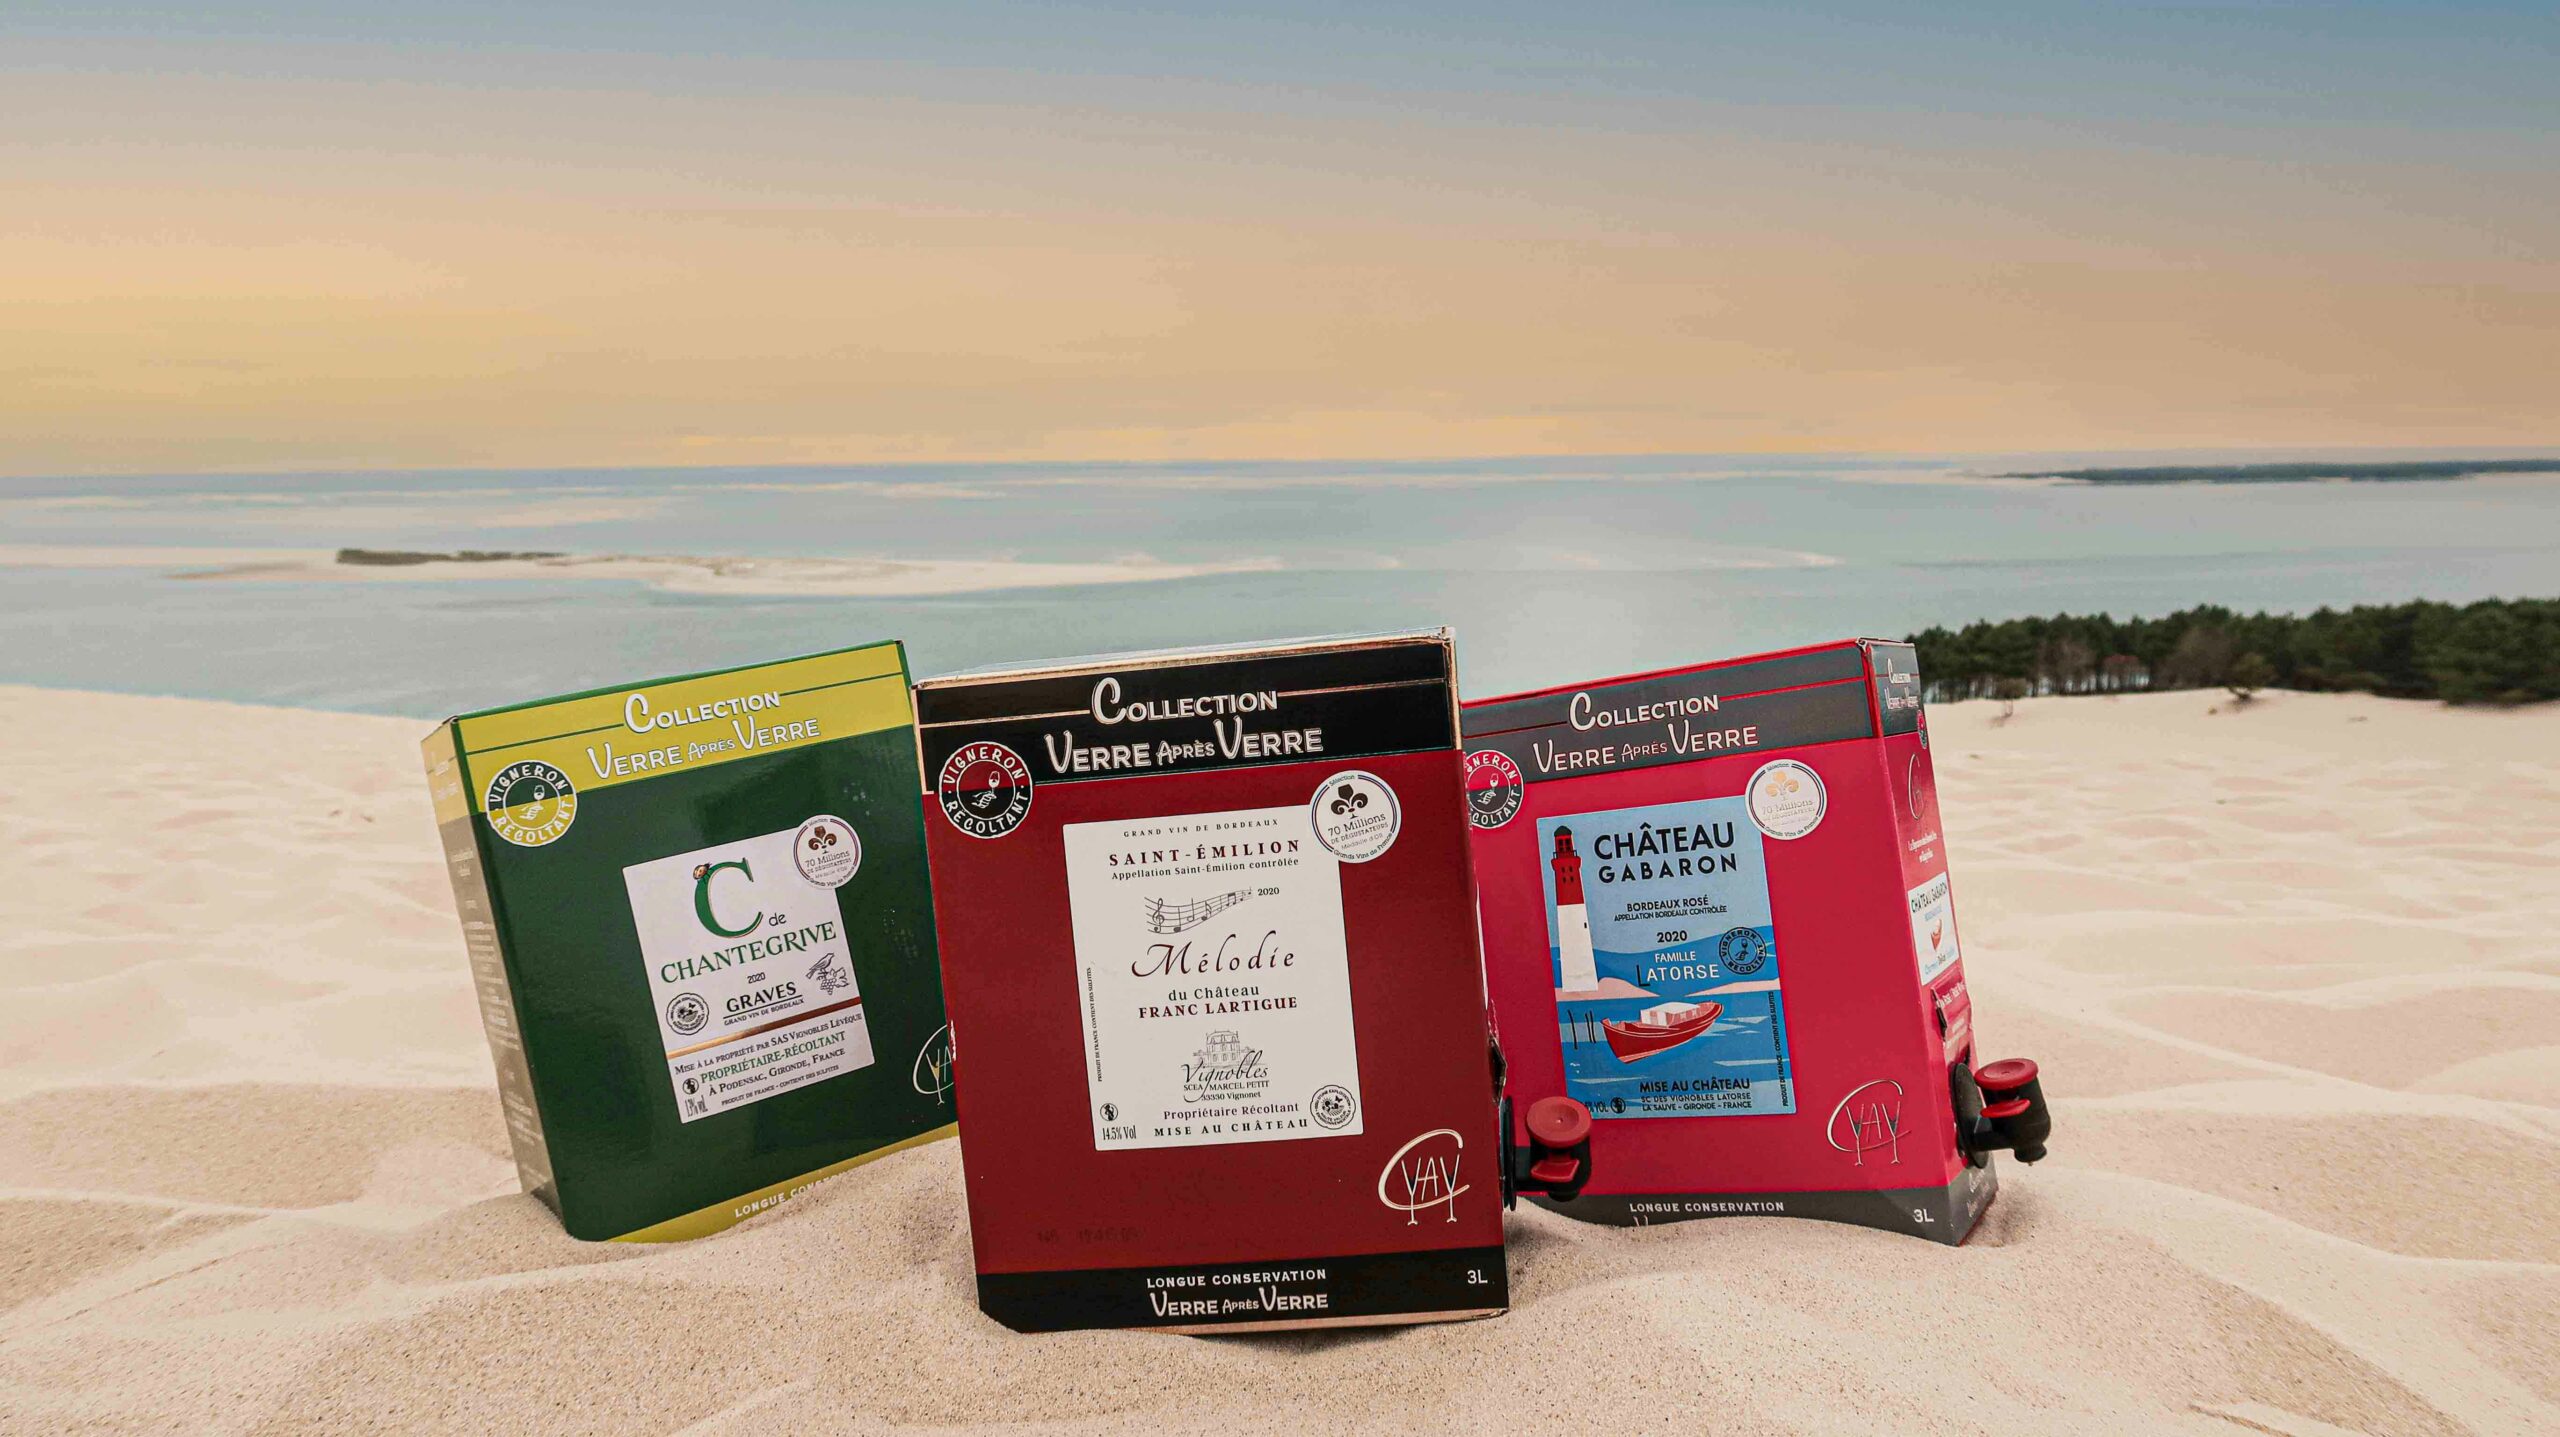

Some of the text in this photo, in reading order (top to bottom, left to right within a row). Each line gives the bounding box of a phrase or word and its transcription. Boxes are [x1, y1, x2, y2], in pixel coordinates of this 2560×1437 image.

[624, 691, 781, 733] COLLECTION
[1091, 677, 1278, 724] COLLECTION
[1569, 691, 1720, 731] COLLECTION
[586, 743, 684, 779] VERRE
[732, 715, 821, 750] VERRE
[1044, 715, 1323, 774] VERRE APRÈS VERRE
[1532, 739, 1616, 773] VERRE
[1667, 720, 1759, 755] VERRE
[943, 746, 1025, 784] VIGNERON
[489, 764, 568, 803] VIGNERON
[1124, 818, 1279, 838] GRAND VIN DE BORDEAUX
[1327, 813, 1386, 837] 70 Millions
[1594, 821, 1735, 860] CHÂTEAU
[817, 850, 850, 865] Millions
[1109, 839, 1299, 867] SAINT-ÉMILION
[1112, 857, 1299, 881] Appellation Saint-Émilion contrôlée
[1598, 853, 1738, 884] GABARON
[694, 857, 787, 938] C de
[1257, 886, 1280, 896] 2020
[1627, 894, 1709, 912] BORDEAUX ROSÉ
[1614, 904, 1727, 922] APPELLATION BORDEAUX CONTRÔLÉE
[1657, 930, 1688, 943] 2020
[1721, 930, 1756, 957] VIGNERON
[660, 921, 837, 983] CHANTEGRIVE
[1131, 930, 1294, 977] Mélodie
[1655, 951, 1696, 963] FAMILLE
[747, 972, 766, 984] 2020
[1636, 963, 1720, 987] LATORSE
[726, 982, 797, 1013] GRAVES
[1168, 986, 1260, 1001] du Château
[724, 999, 804, 1026] GRAND VIN DE BORDEAUX
[1139, 996, 1298, 1019] FRANC LARTIGUE
[701, 1031, 846, 1084] PROPRIÉTAIRE-RÉCOLTANT
[704, 1058, 714, 1067] LA
[756, 1042, 770, 1051] PAR
[771, 1033, 789, 1047] SAS
[709, 1084, 717, 1096] À
[812, 1048, 846, 1065] FRANCE
[1181, 1049, 1269, 1103] Vignobles
[1183, 1084, 1204, 1092] SCEA
[1209, 1081, 1245, 1091] MARCEL
[1226, 1091, 1262, 1101] Vignonet
[1640, 1076, 1750, 1093] MISE AU CHÂTEAU
[1780, 1083, 1788, 1107] PRODUIT
[1641, 1092, 1751, 1103] SC DES VIGNOBLES LATORSE
[1642, 1100, 1752, 1111] LA SAUVE GIRONDE FRANCE
[1163, 1107, 1238, 1121] Propriétaire
[1242, 1103, 1300, 1115] Récoltant
[1123, 1125, 1137, 1140] Vol
[1154, 1118, 1308, 1138] MISE AU CHÂTEAU
[734, 1191, 785, 1218] LONGUE
[1629, 1201, 1785, 1213] LONGUE CONSERVATION
[1913, 1208, 1934, 1223] 3L
[1147, 1269, 1327, 1288] LONGUE CONSERVATION
[1467, 1270, 1488, 1285] 3L
[1150, 1291, 1219, 1318] VERRE
[1259, 1285, 1329, 1312] VERRE
